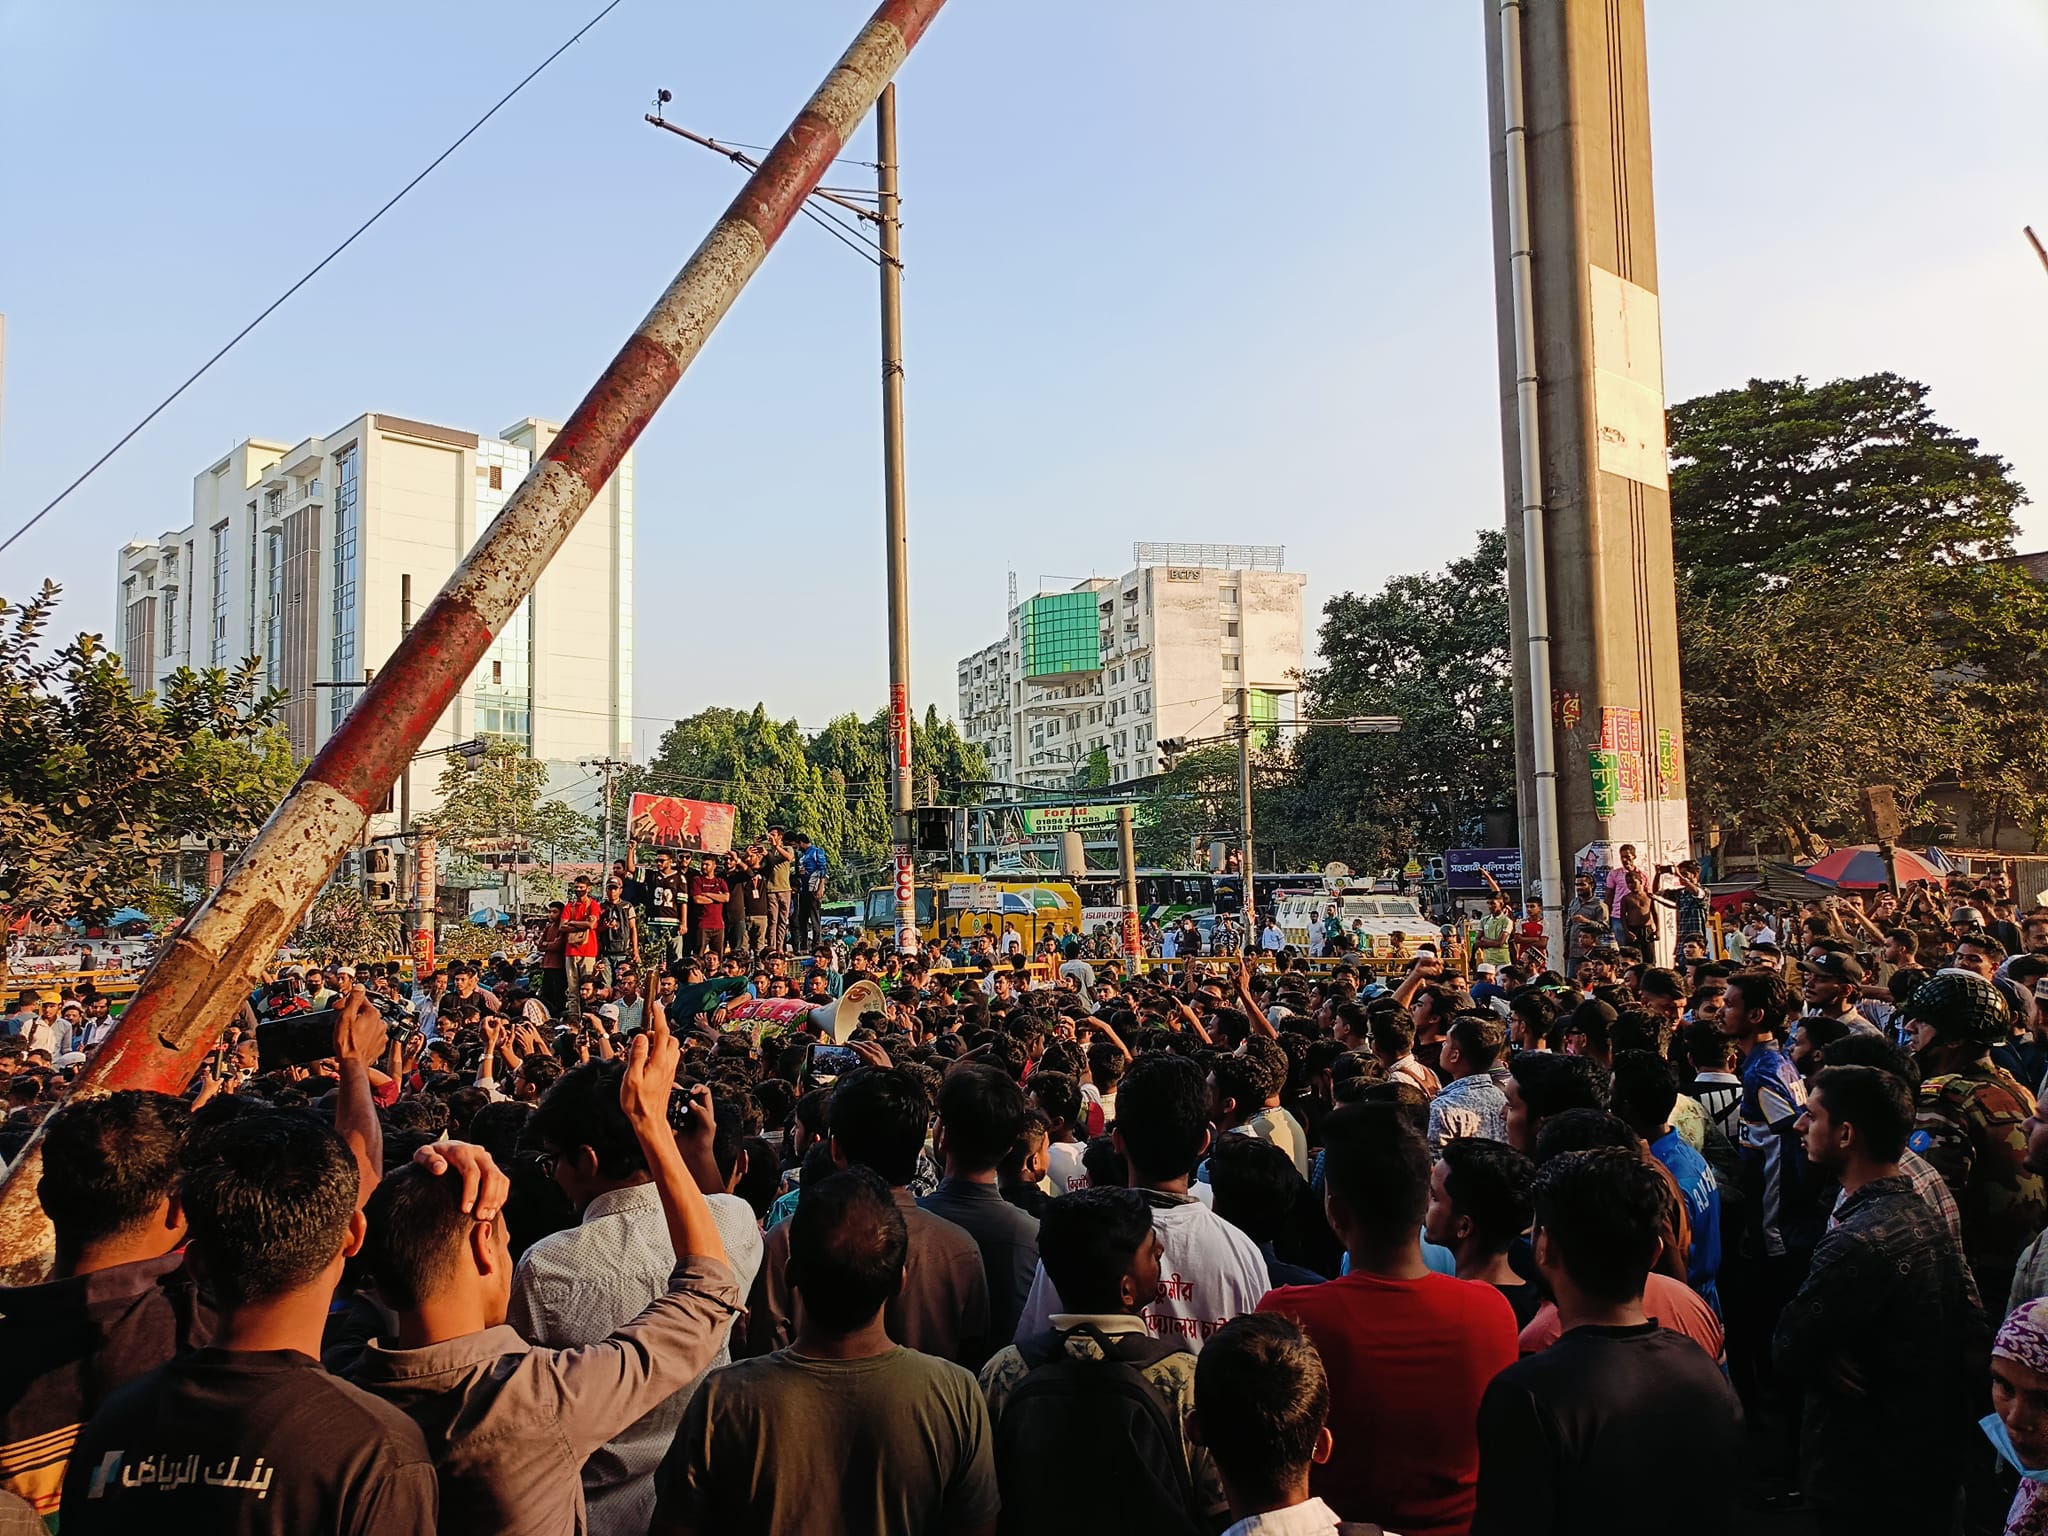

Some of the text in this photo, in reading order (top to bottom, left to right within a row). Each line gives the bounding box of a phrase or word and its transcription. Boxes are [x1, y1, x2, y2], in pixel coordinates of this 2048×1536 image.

[1170, 569, 1201, 580] BCPS
[1044, 809, 1066, 817] For
[896, 855, 912, 901] UCC
[122, 1454, 199, 1491] الرياض
